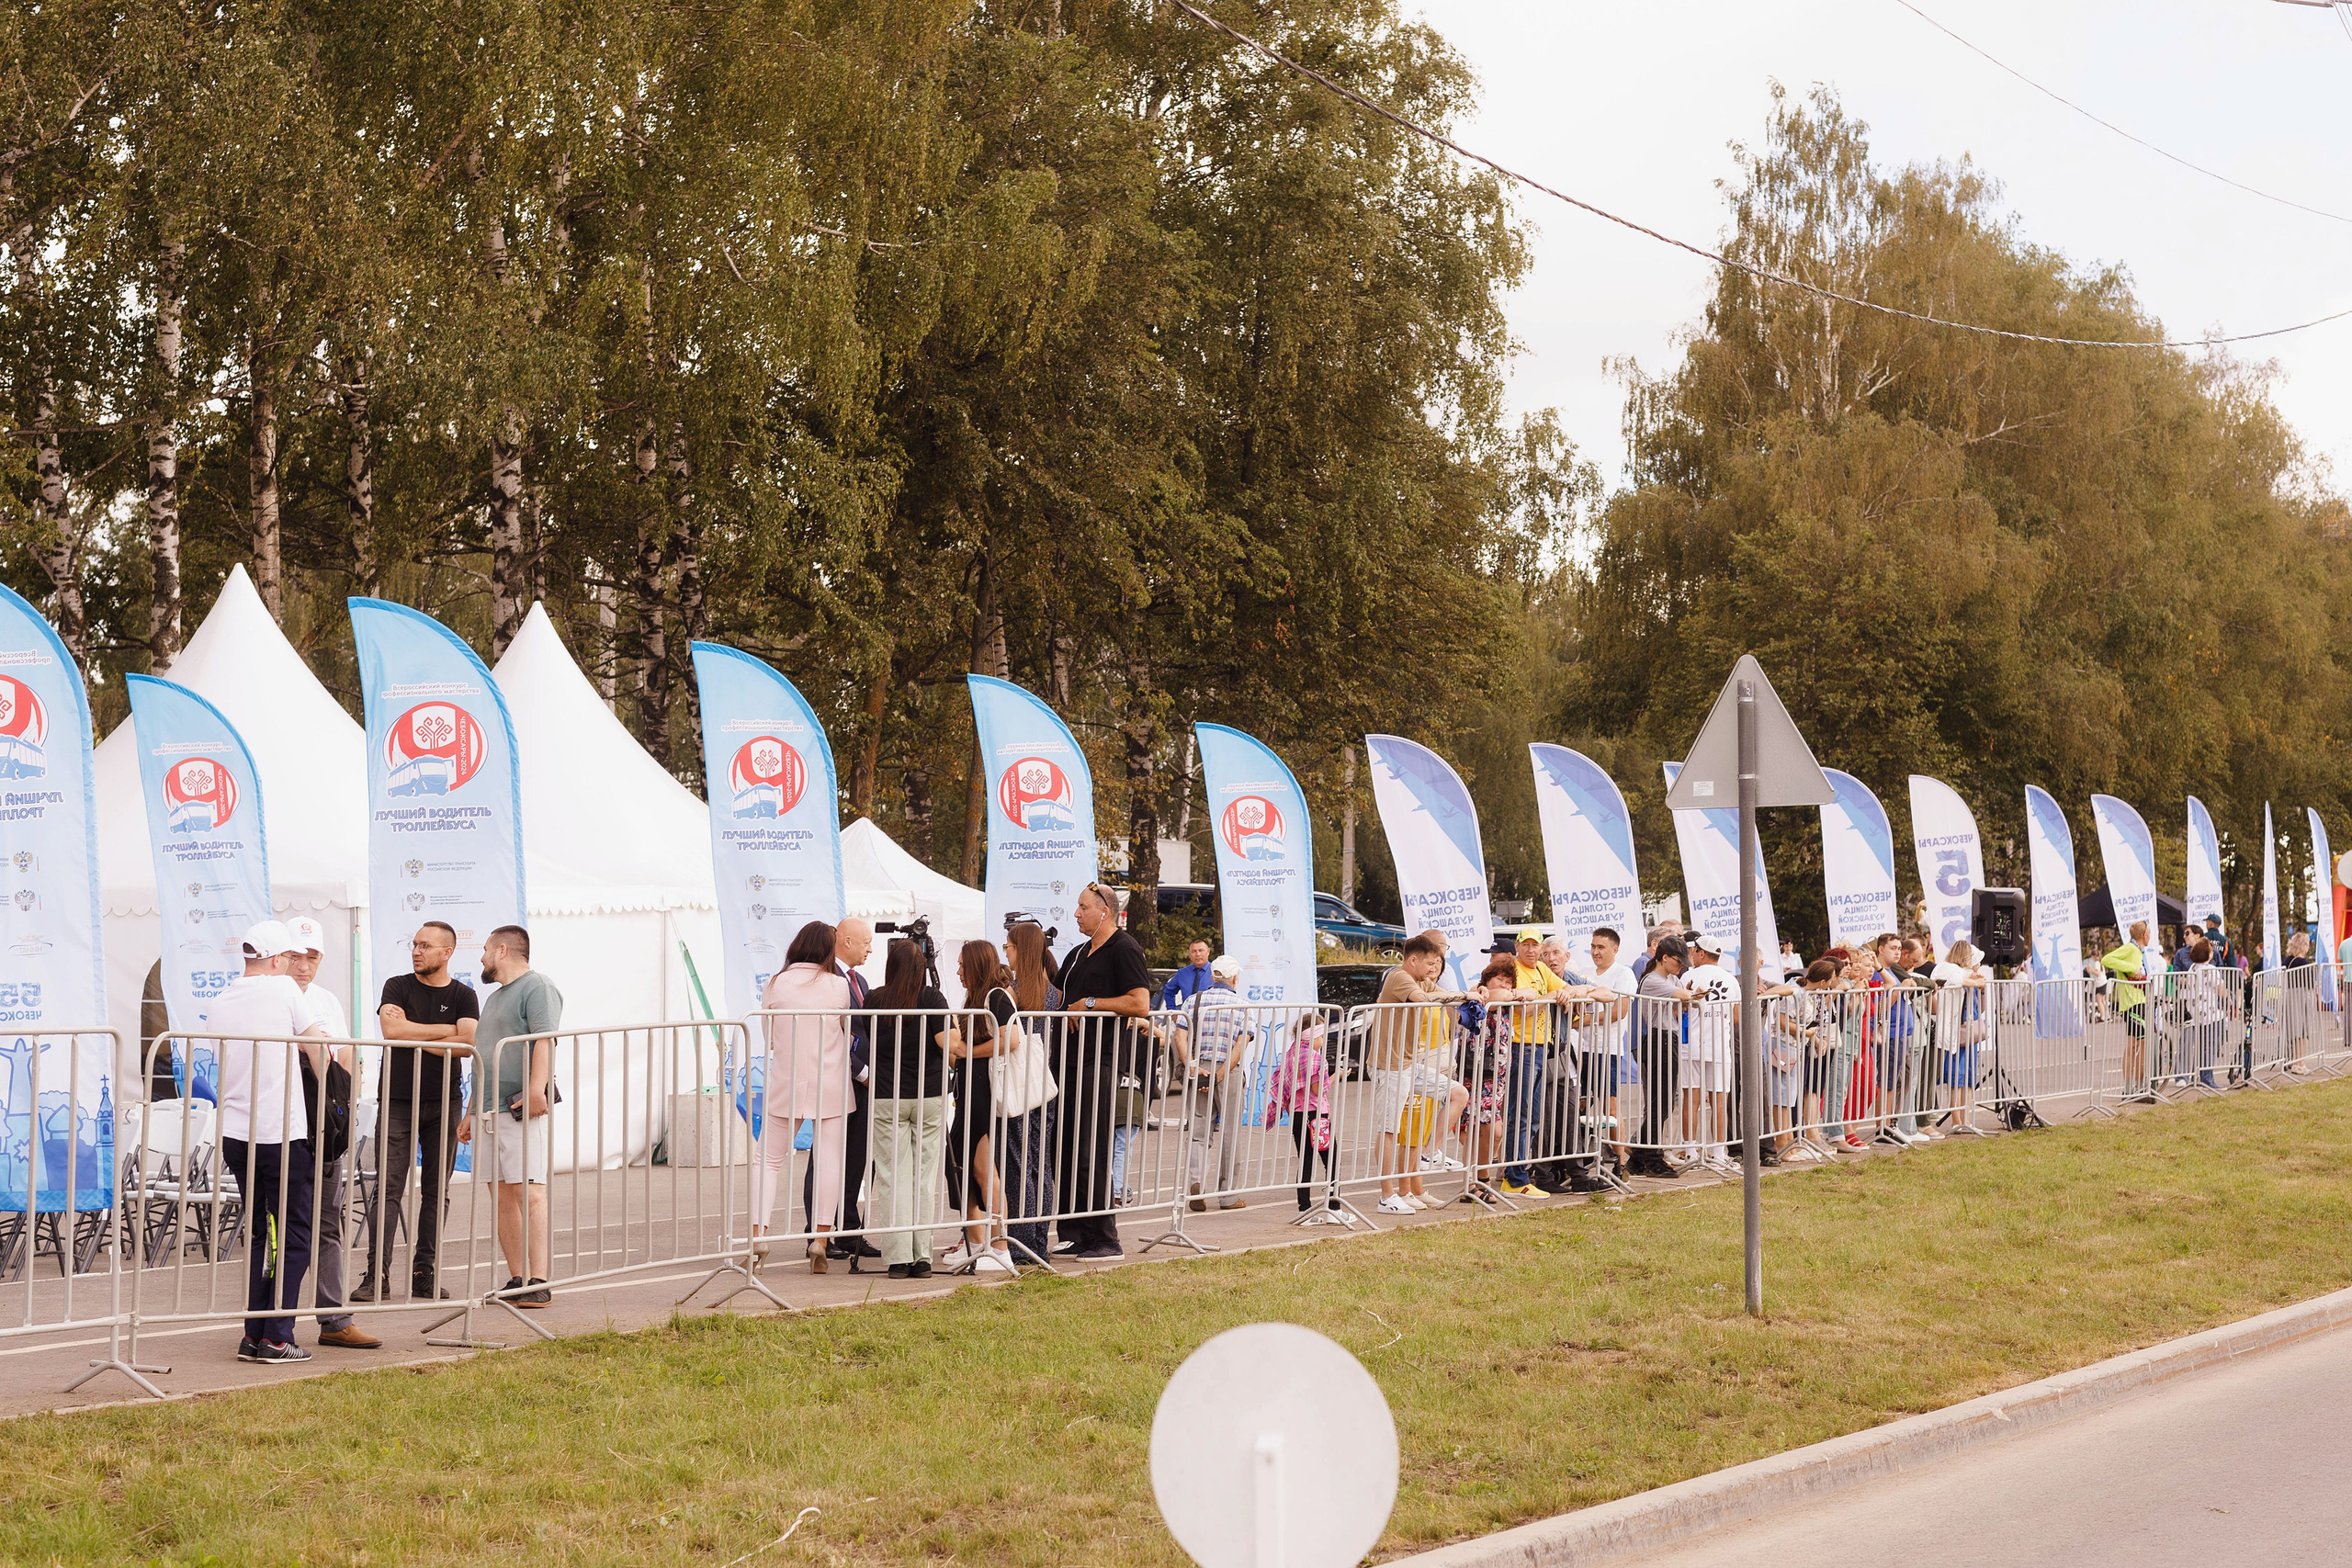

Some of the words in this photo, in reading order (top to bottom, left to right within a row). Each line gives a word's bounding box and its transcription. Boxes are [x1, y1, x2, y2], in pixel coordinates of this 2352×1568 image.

[375, 807, 426, 821] ЛУЧШИЙ
[429, 807, 492, 819] ВОДИТЕЛЬ
[390, 818, 477, 832] ТРОЛЛЕЙБУСА
[722, 829, 765, 840] ЛУЧШИЙ
[766, 829, 813, 840] ВОДИТЕЛЬ
[162, 840, 199, 853] ЛУЧШИЙ
[201, 840, 243, 851] ВОДИТЕЛЬ
[736, 840, 801, 852] ТРОЛЛЕЙБУСА
[175, 851, 235, 862] ТРОЛЛЕЙБУСА
[192, 990, 222, 998] ЧЕБОК
